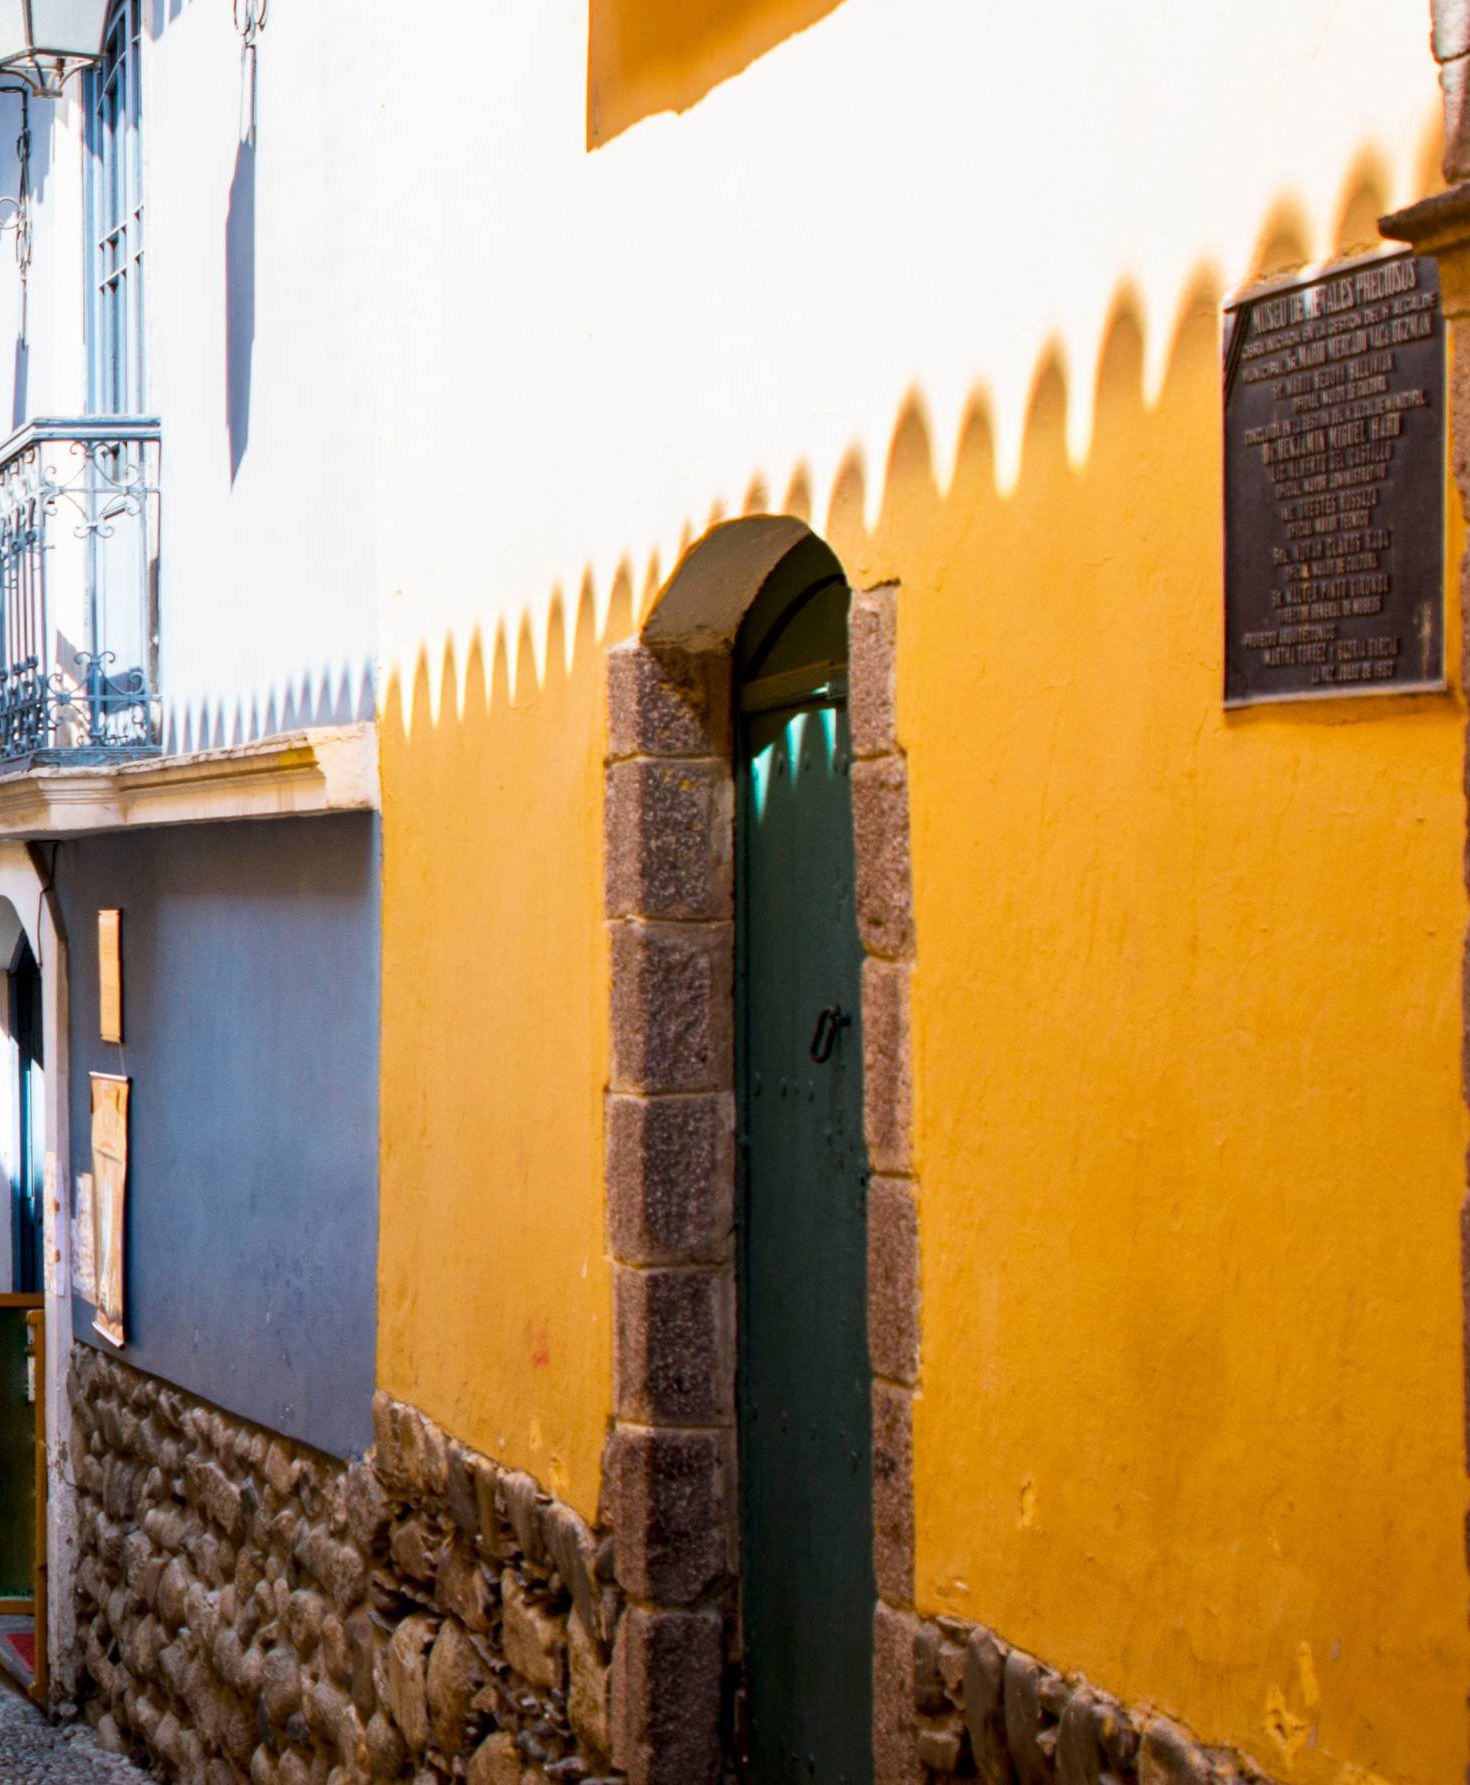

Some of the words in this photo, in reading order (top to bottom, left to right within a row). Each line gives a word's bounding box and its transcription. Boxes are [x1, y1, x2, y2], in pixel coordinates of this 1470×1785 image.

[1253, 296, 1287, 333] MUSEO
[1289, 292, 1303, 323] DE
[1304, 278, 1353, 318] METALES
[1355, 260, 1415, 303] PRECIOSOS
[1329, 420, 1365, 448] MIGUEL
